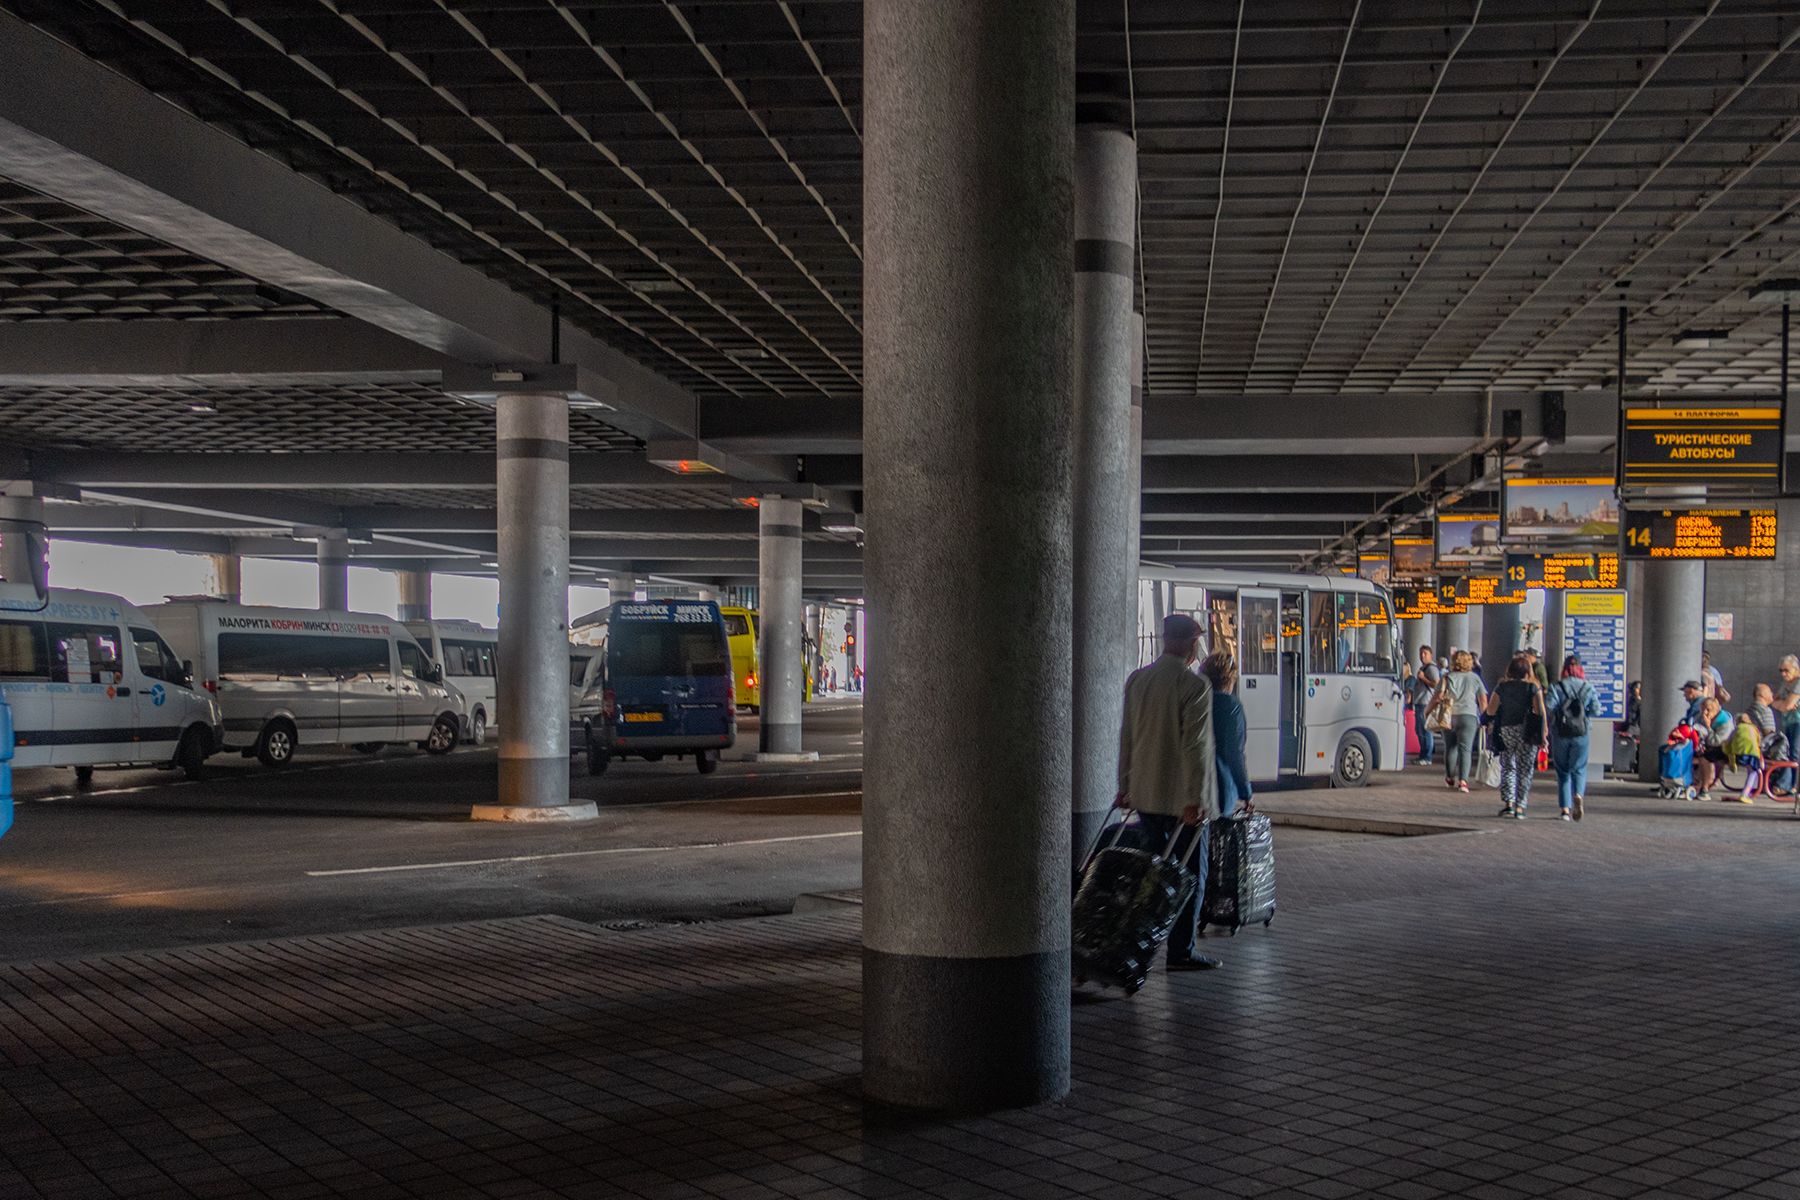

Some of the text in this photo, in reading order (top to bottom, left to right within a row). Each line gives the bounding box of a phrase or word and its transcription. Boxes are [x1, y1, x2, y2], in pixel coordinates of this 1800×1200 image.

[1654, 433, 1752, 445] ТУРИСТИЧЕСКИЕ
[1669, 447, 1735, 459] АВТОБУСЫ
[1689, 509, 1741, 517] НАПРАВЛЕНИЕ
[1626, 527, 1651, 547] 14
[1675, 526, 1722, 536] БОБРУЙСК
[1675, 537, 1722, 547] БОБРУЙСК
[1508, 565, 1526, 581] 13
[1441, 585, 1456, 598] 12
[1395, 597, 1405, 608] 11
[218, 617, 271, 629] МАЛОРИТА
[271, 620, 303, 631] КОБРИН
[303, 621, 331, 632] МИНСК
